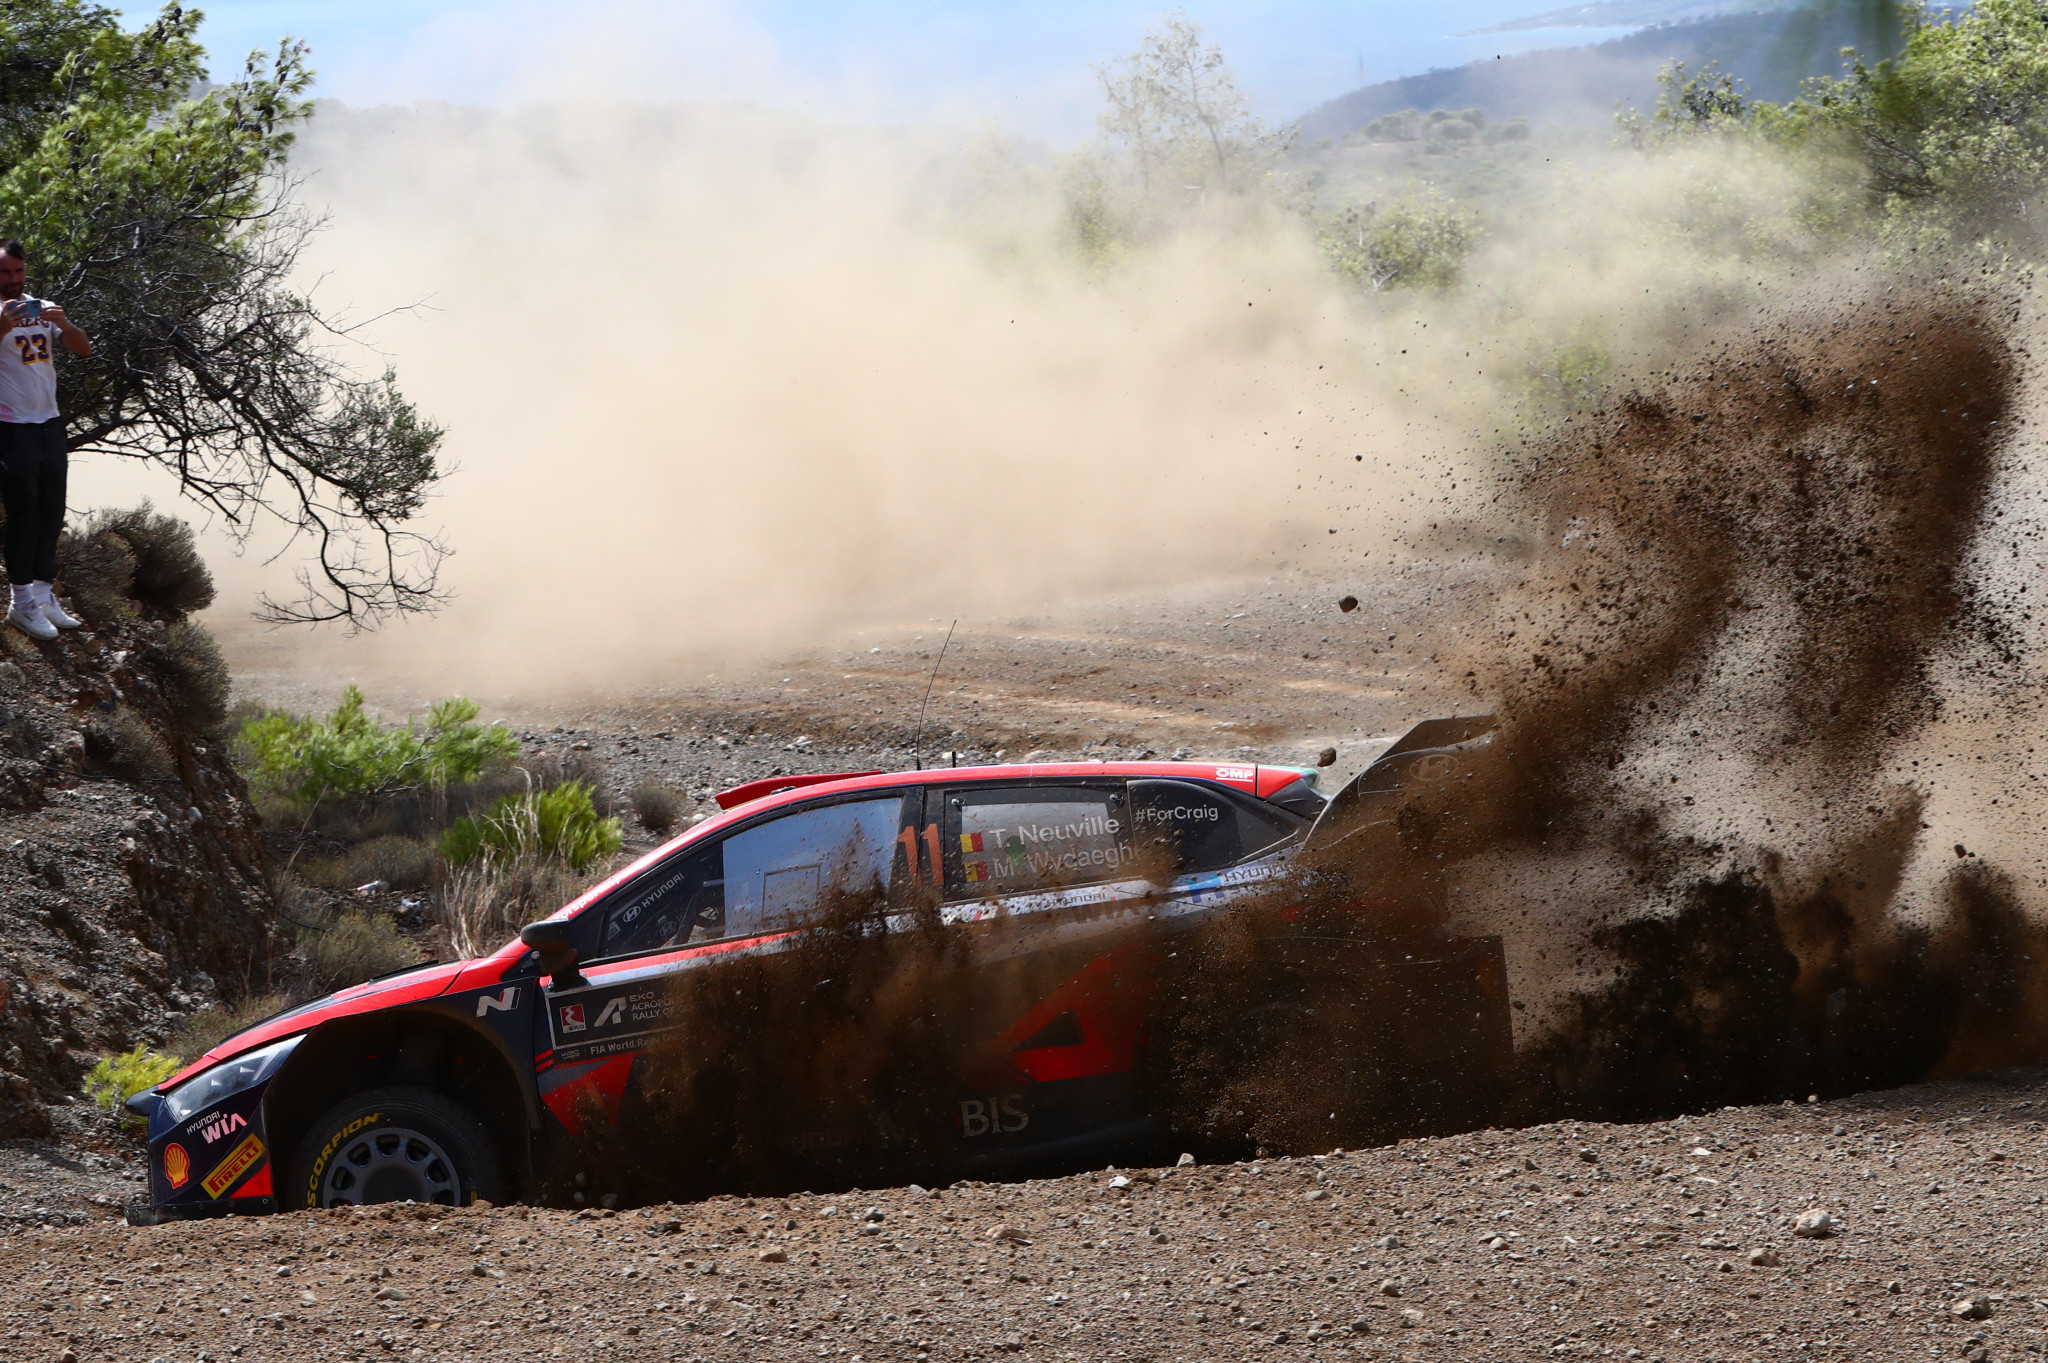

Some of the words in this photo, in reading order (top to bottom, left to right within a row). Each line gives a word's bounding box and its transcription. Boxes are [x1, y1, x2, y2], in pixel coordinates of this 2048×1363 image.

[15, 333, 49, 365] 23
[1216, 768, 1254, 780] OMP
[1136, 804, 1219, 822] #ForCraig
[1018, 816, 1120, 846] Neuville
[898, 822, 944, 887] 11
[1025, 842, 1138, 874] Wydaegh
[641, 872, 685, 908] HYUNDAI
[630, 991, 655, 1002] EKO
[632, 1009, 660, 1021] RALLY
[590, 1044, 606, 1056] FIA
[608, 1041, 635, 1052] World
[186, 1110, 220, 1135] HYUNDAI
[950, 1094, 1029, 1138] BIS
[207, 1140, 260, 1193] PIRELLI
[307, 1112, 380, 1207] SCORPION
